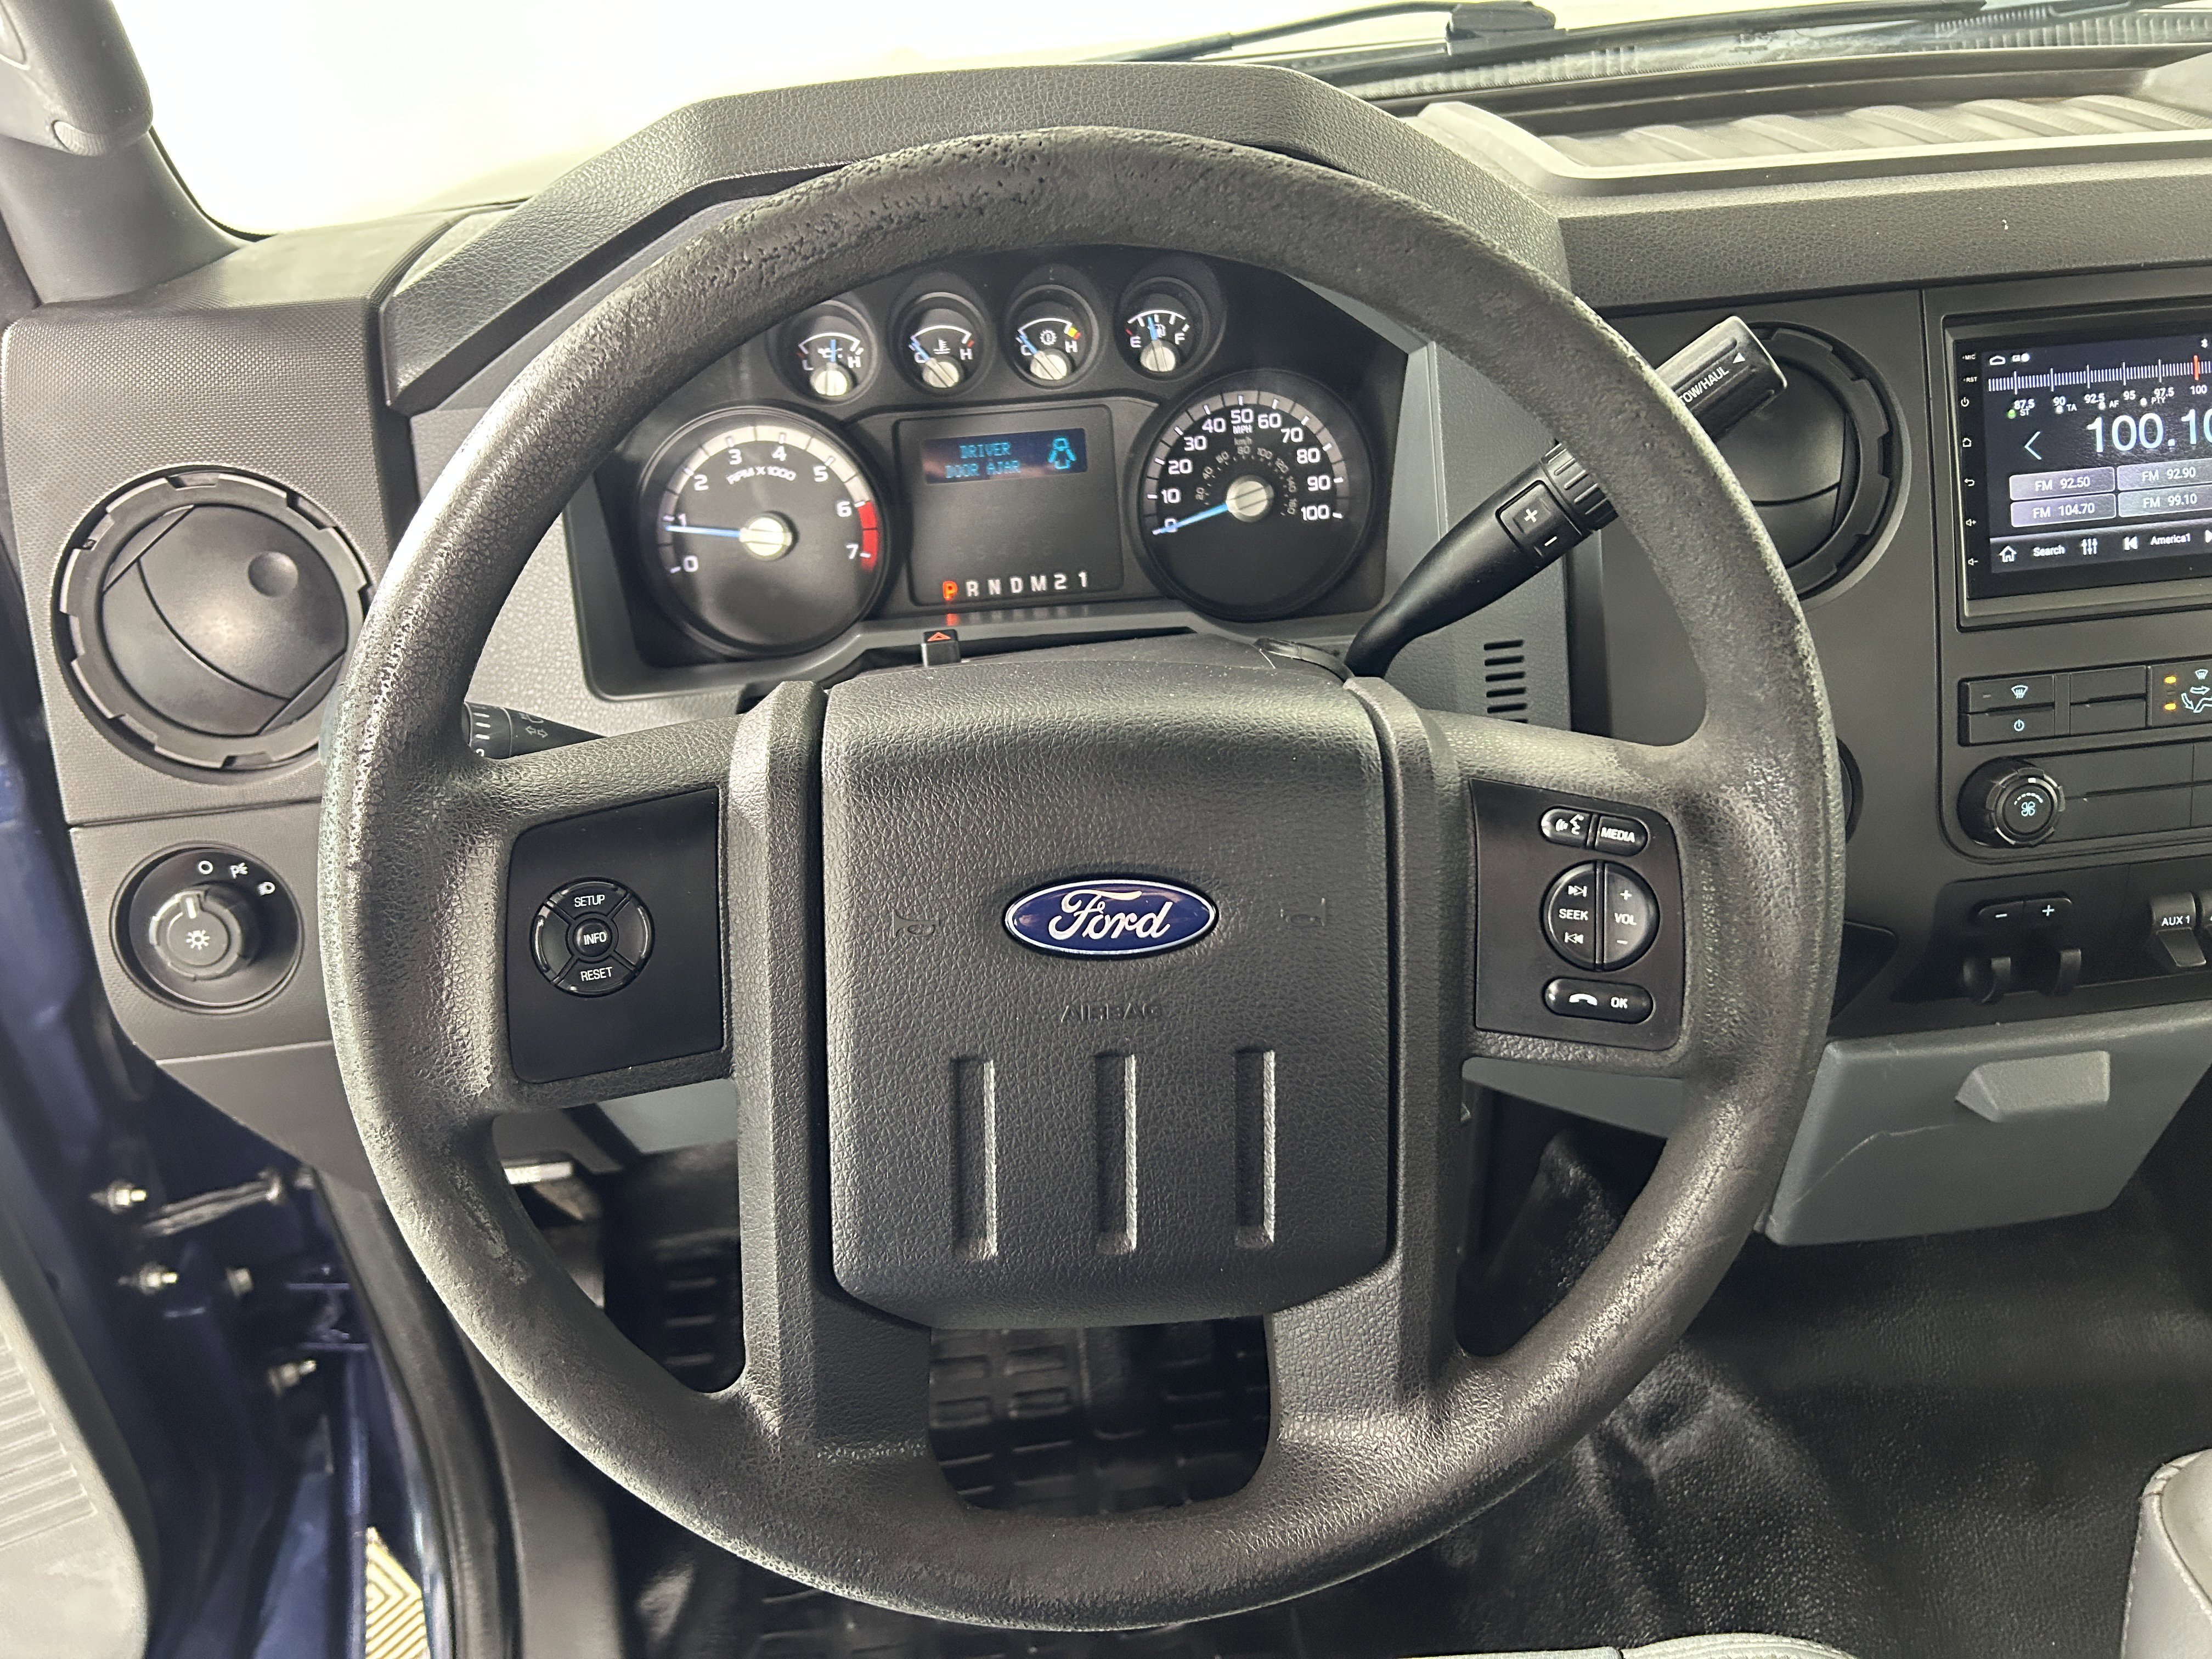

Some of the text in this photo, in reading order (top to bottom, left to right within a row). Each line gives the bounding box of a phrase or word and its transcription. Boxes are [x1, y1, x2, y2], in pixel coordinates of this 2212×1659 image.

[1130, 336, 1141, 348] E
[1175, 332, 1185, 345] F
[960, 348, 973, 360] H
[1065, 341, 1077, 353] H
[802, 359, 814, 371] L
[848, 356, 861, 368] H
[1677, 366, 1729, 407] TOW/HAUL
[2013, 385, 2208, 410] 87.5 90 92.5 95 97.5 100
[2109, 400, 2119, 408] AF
[1230, 409, 1254, 424] 50
[1258, 413, 1282, 428] 60
[1202, 417, 1226, 433] 40
[1233, 425, 1252, 434] MPH
[1281, 427, 1303, 443] 70
[1184, 436, 1207, 451] 30
[728, 449, 742, 465] 3
[772, 446, 787, 461] 4
[1296, 448, 1320, 464] 80
[768, 466, 796, 481] 1000
[813, 466, 828, 482] 5
[1168, 459, 1193, 475] 20
[2142, 466, 2196, 482] FM 92.90
[693, 474, 708, 490] 2
[1307, 475, 1331, 491] 90
[2035, 476, 2091, 491] FM 92.50
[1161, 488, 1181, 504] 10
[2143, 493, 2197, 509] FM 99.10
[836, 501, 851, 517] 6
[1301, 505, 1330, 521] 100
[2033, 503, 2095, 519] FM 104.70
[678, 513, 686, 527] 1
[2150, 533, 2191, 545] America1
[846, 544, 859, 560] 7
[2033, 544, 2066, 557] Search
[684, 555, 698, 572] 0
[942, 570, 1088, 600] P R N D M 2 1
[1600, 827, 1635, 843] MEDIA
[574, 894, 606, 908] SETUP
[1048, 889, 1173, 940] Ford
[1559, 908, 1589, 921] SEEK
[1614, 912, 1637, 926] VOL
[2161, 915, 2190, 926] AUX 1
[583, 931, 607, 945] INFO
[580, 967, 613, 981] RESET
[1610, 996, 1628, 1009] OK
